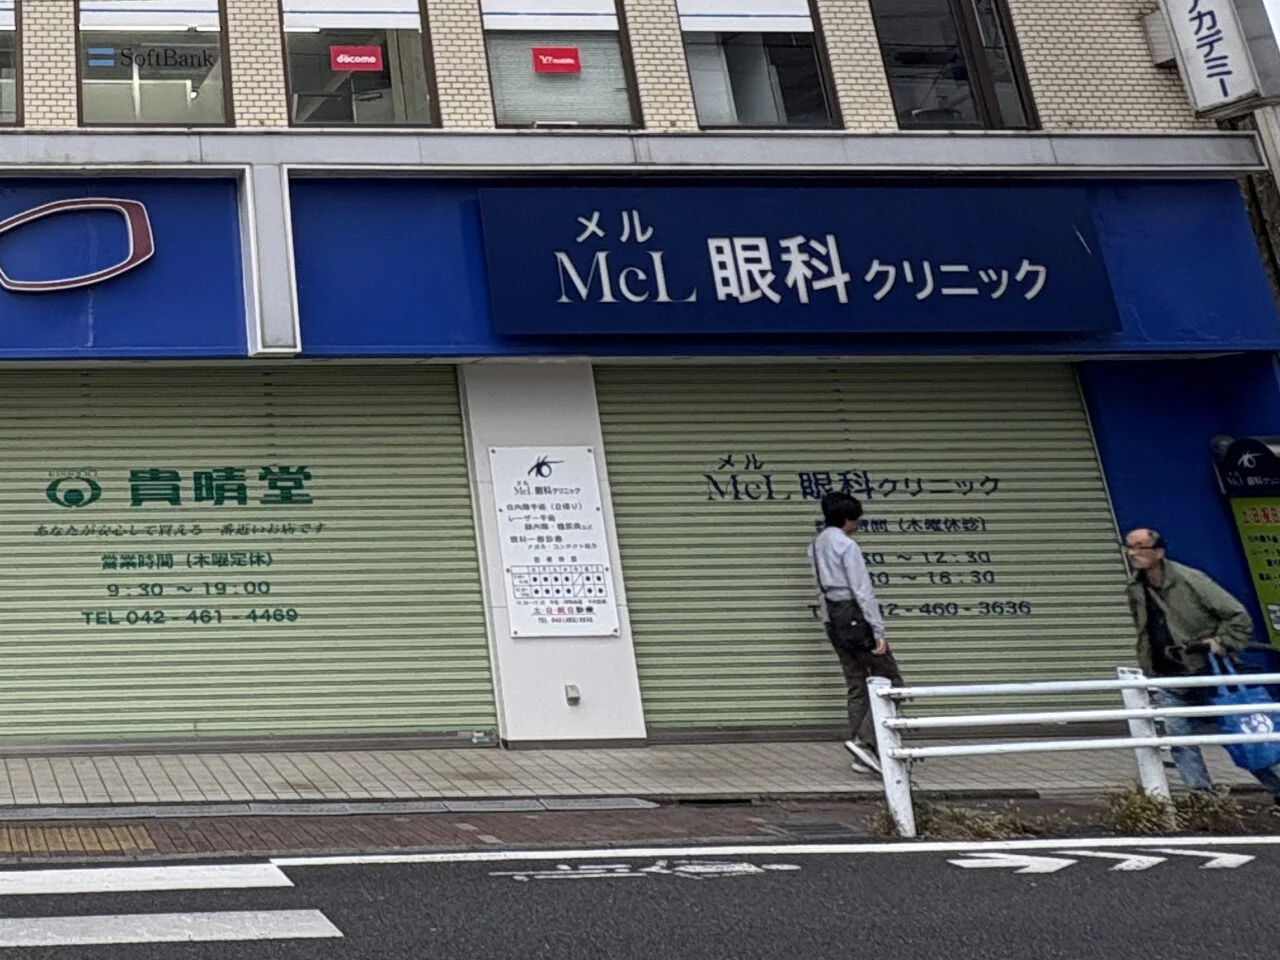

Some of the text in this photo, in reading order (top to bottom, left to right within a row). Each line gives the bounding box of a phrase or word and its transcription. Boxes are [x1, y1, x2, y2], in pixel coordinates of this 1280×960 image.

[121, 48, 215, 69] SoftBank
[575, 209, 654, 243] メル
[553, 250, 697, 304] McL
[718, 454, 764, 470] メル
[128, 464, 314, 507] 貴晴堂
[81, 612, 120, 626] TEL
